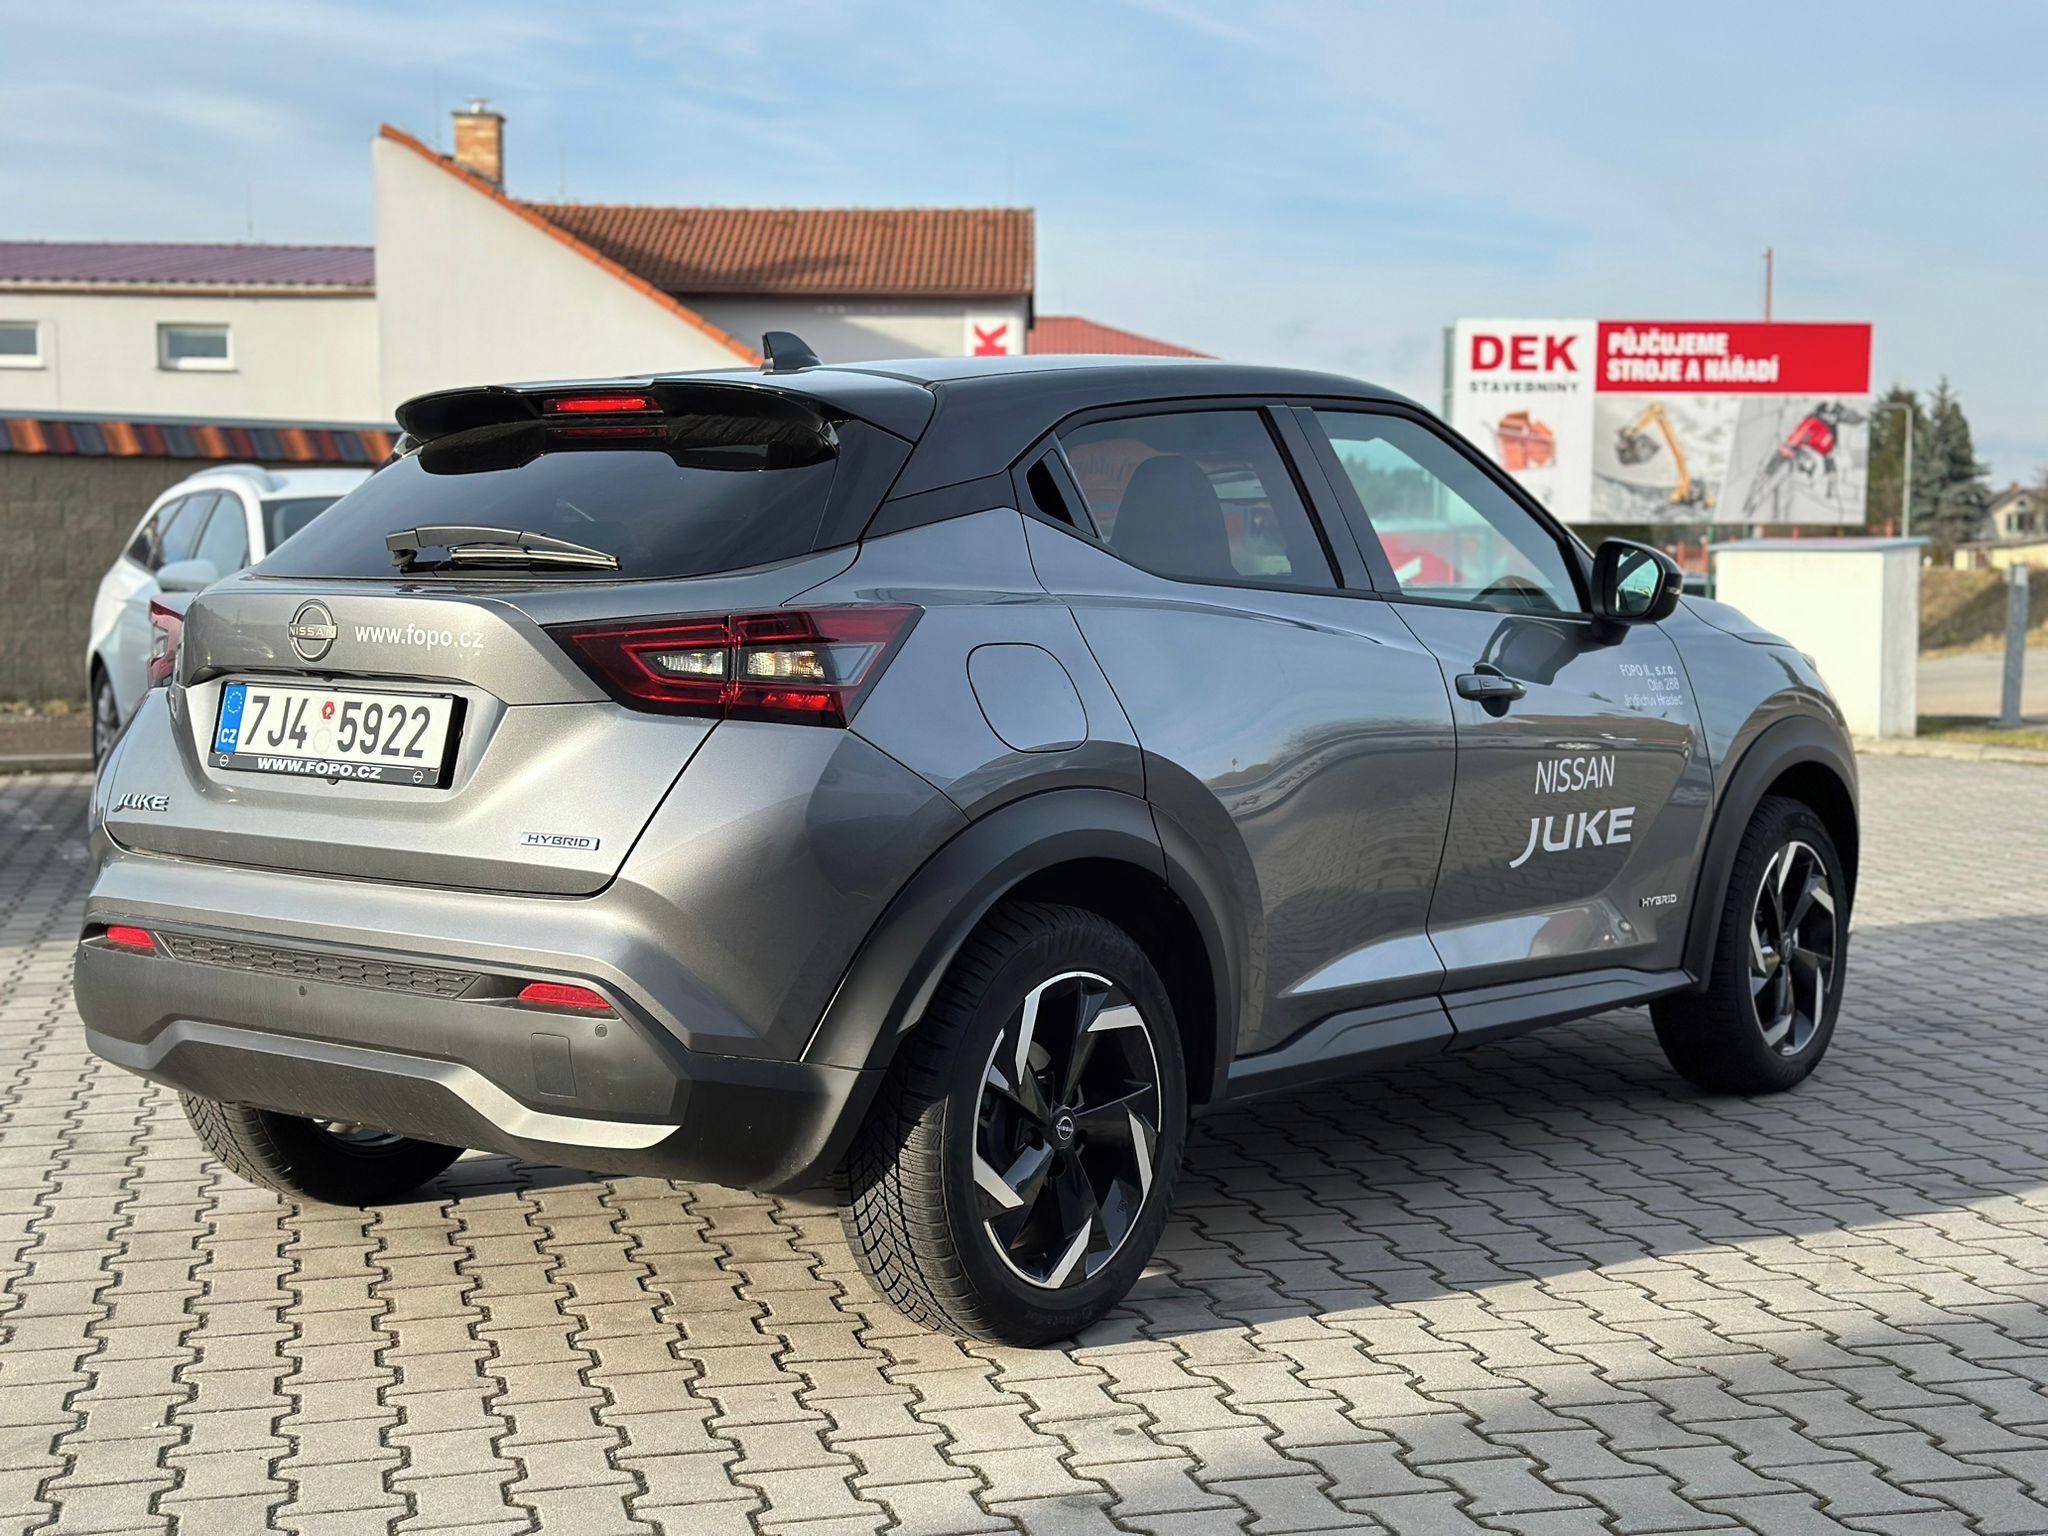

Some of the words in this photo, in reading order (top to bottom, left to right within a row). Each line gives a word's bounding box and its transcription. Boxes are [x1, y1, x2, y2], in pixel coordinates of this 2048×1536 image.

[1472, 335, 1579, 372] DEK
[1608, 328, 1729, 357] PŮJČUJEME
[1607, 359, 1681, 382] STROJE
[1685, 360, 1700, 382] A
[290, 627, 337, 639] NISSAN
[354, 624, 485, 650] www.fopo.cz
[1618, 663, 1643, 677] FOPO
[1655, 665, 1677, 677] s.r.o.
[221, 728, 236, 744] CZ
[245, 696, 309, 749] 7J4
[337, 702, 431, 759] 5922
[257, 757, 382, 779] WWW.FOPO.CZ
[1535, 755, 1616, 796] NISSAN
[112, 792, 170, 812] JUKE
[527, 834, 590, 848] HYBRID
[1509, 806, 1637, 869] JUKE
[1641, 893, 1677, 908] HYBRID
